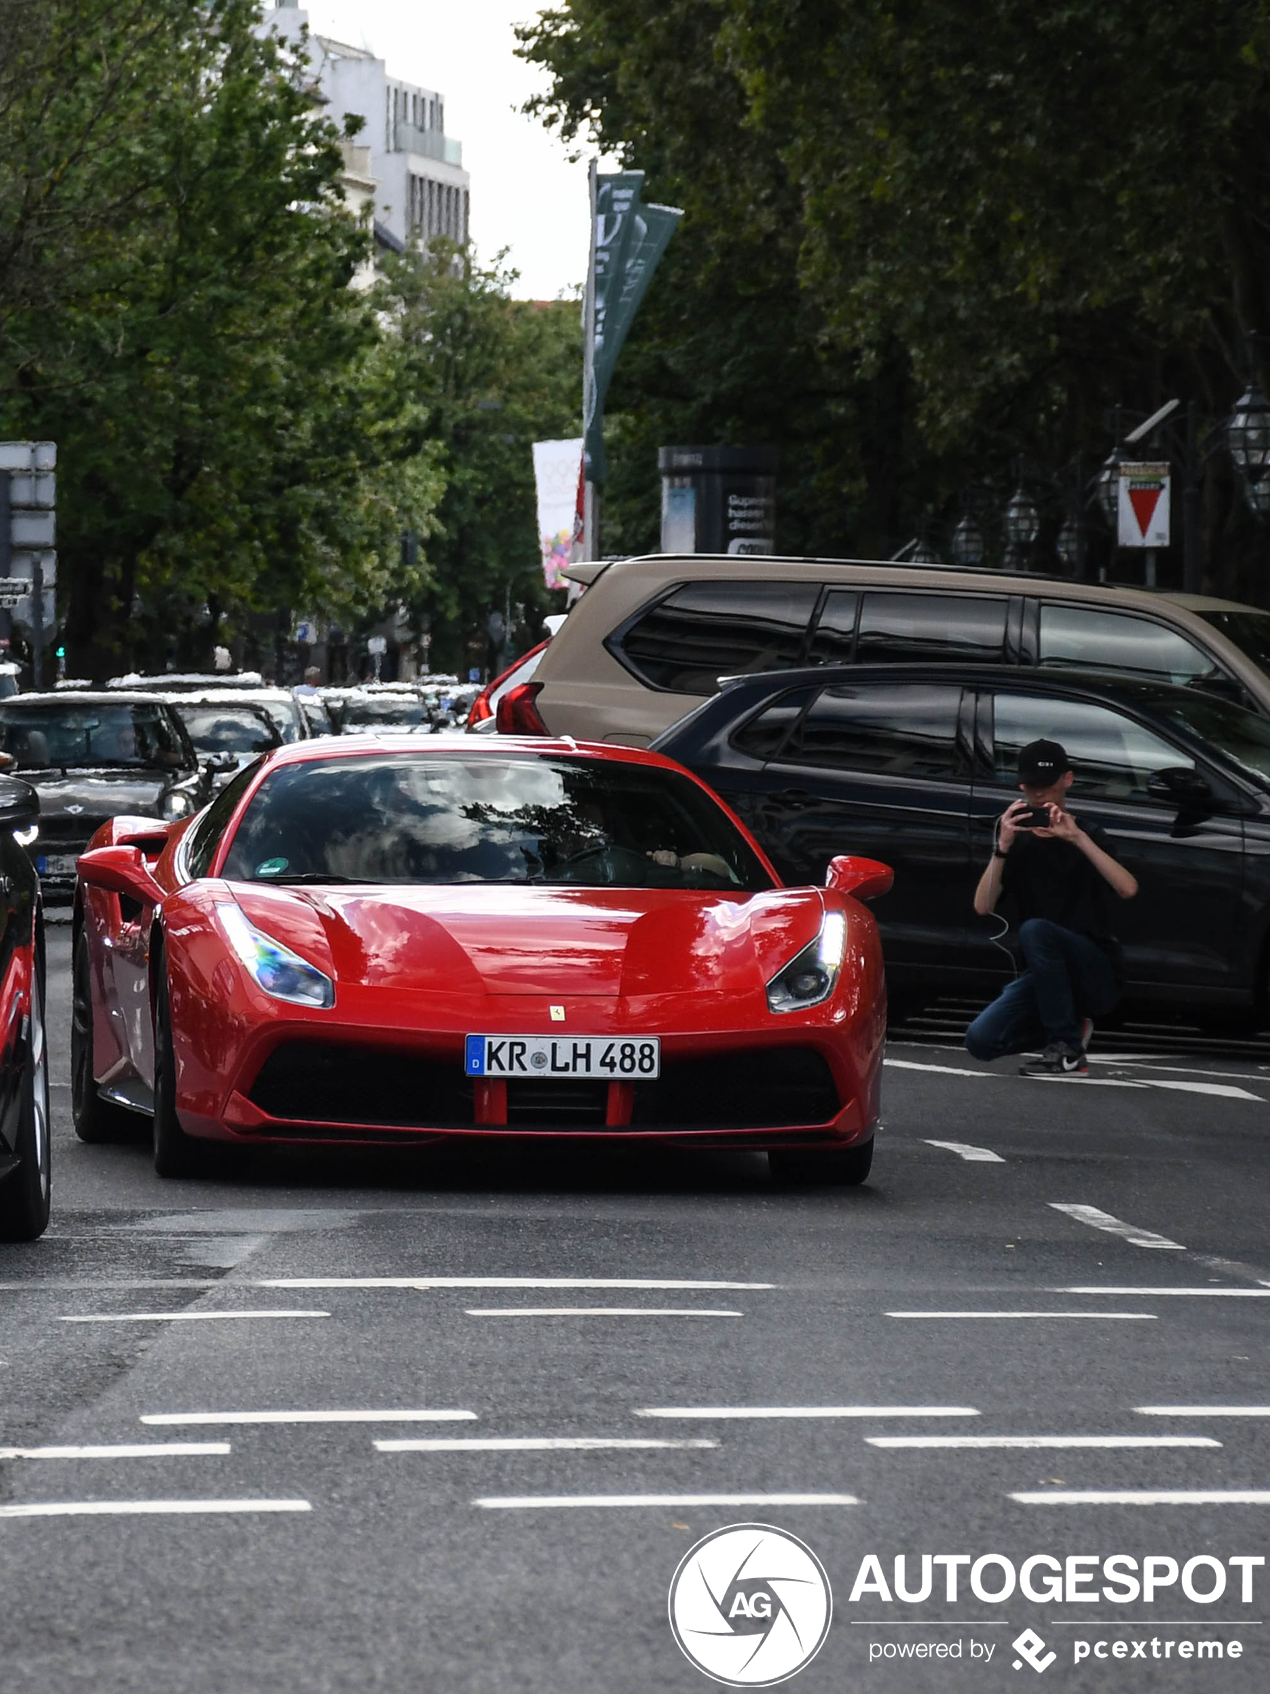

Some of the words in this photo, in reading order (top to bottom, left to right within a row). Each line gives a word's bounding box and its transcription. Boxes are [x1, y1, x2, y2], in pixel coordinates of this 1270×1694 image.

[487, 1041, 528, 1072] KR
[550, 1042, 592, 1073] LH
[599, 1043, 655, 1074] 488
